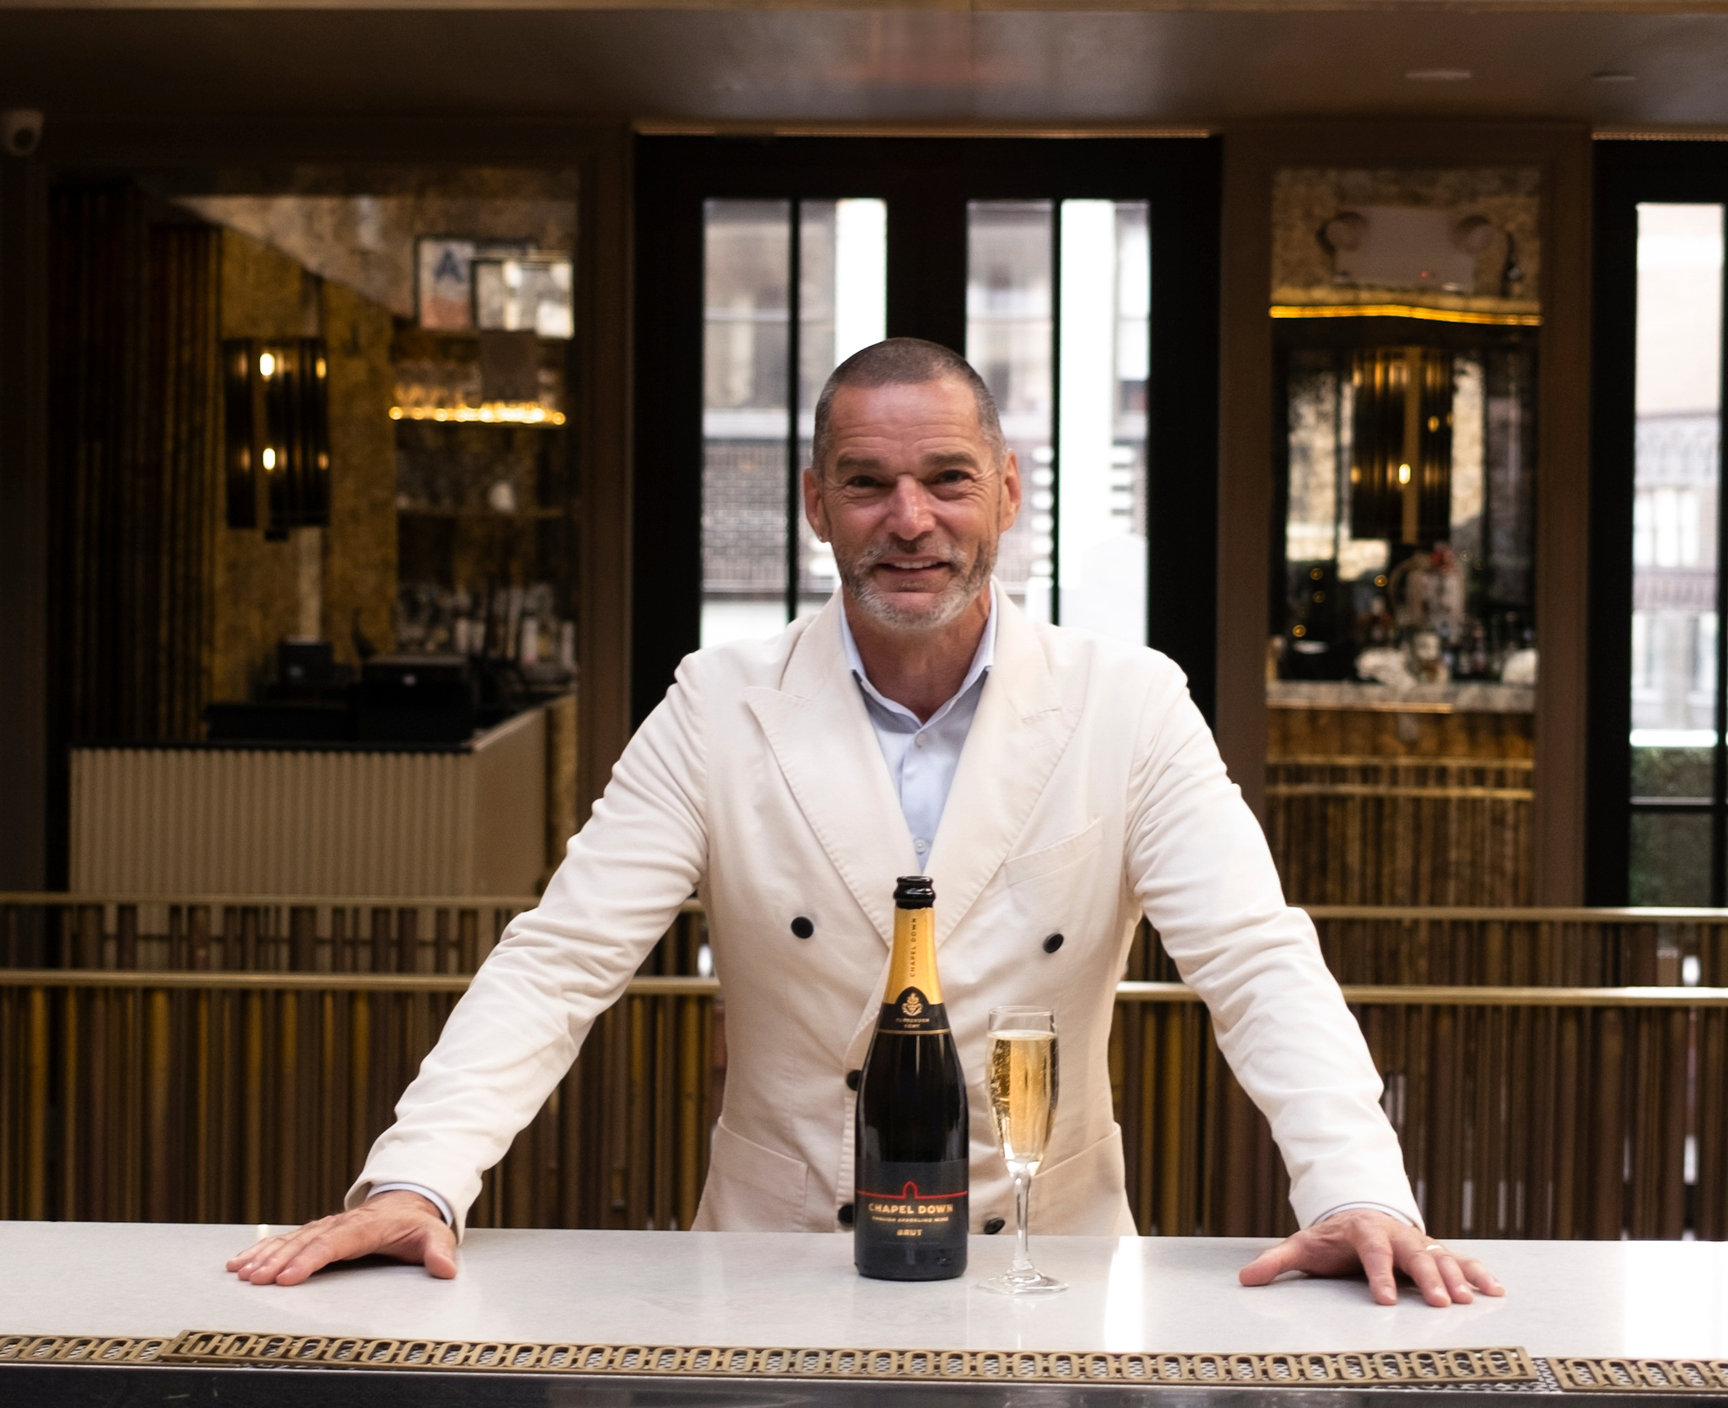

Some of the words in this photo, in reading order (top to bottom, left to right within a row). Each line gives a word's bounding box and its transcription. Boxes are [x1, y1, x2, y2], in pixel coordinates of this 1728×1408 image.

[868, 1203, 915, 1215] CHAPEL
[917, 1204, 954, 1215] DOWN
[896, 1229, 923, 1237] BRUT
